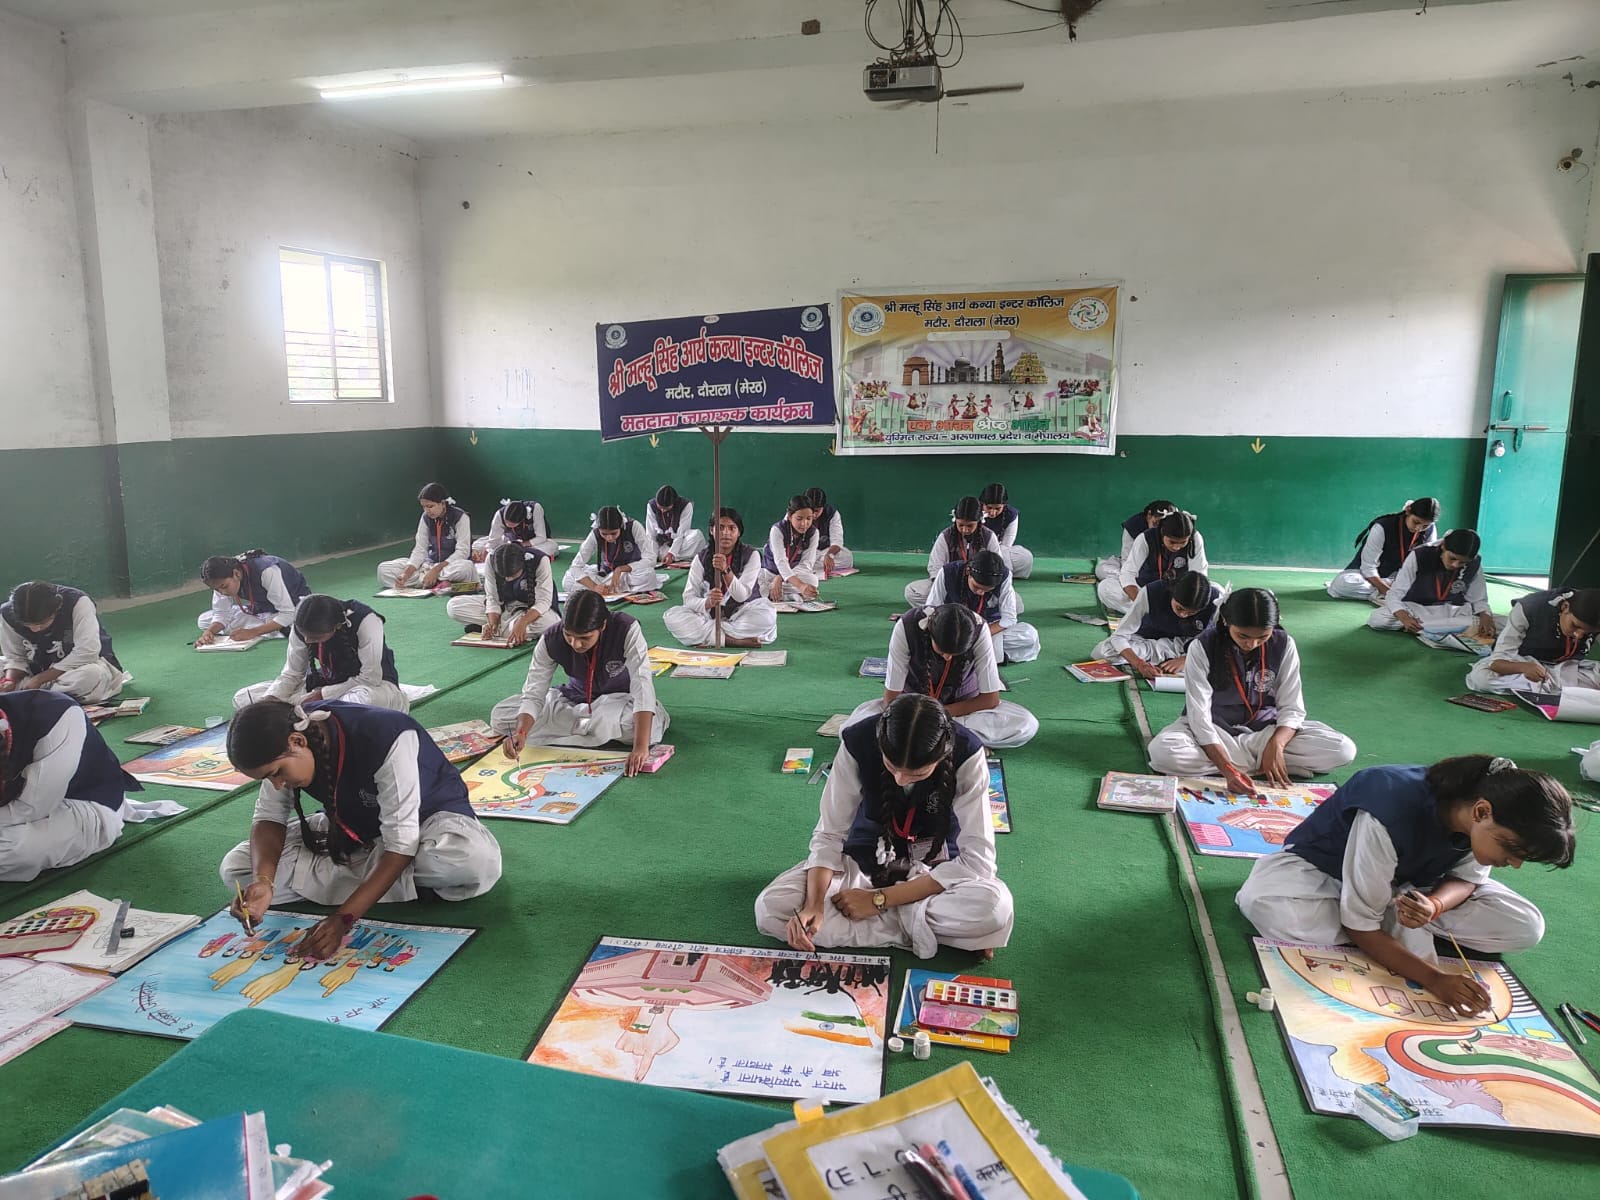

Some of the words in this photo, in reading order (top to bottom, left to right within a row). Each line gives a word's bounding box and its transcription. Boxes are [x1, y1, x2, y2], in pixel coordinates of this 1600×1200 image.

[884, 299, 897, 313] श्री
[898, 300, 922, 316] मल्हू
[923, 298, 943, 312] सिंह
[945, 296, 966, 311] आर्य
[969, 299, 996, 312] कन्या
[999, 297, 1024, 311] इन्टर
[1026, 295, 1065, 309] कॉलिज
[953, 315, 986, 328] दौराला
[989, 314, 1020, 329] (मेरठ)
[608, 358, 625, 398] श्री
[626, 352, 658, 392] मल्हू
[654, 335, 680, 375] सिंह
[681, 326, 708, 367] आर्य
[708, 335, 743, 362] कन्या
[742, 335, 777, 367] इन्टर
[775, 334, 824, 384] कॉलिज
[665, 382, 694, 400] मटौर,
[697, 380, 732, 398] दौराला
[735, 376, 767, 399] (मेरठ)
[620, 412, 678, 432] मतदाता
[749, 397, 814, 423] कार्यक्रम
[907, 419, 932, 432] एक
[975, 417, 1011, 431] श्रेष्ठ
